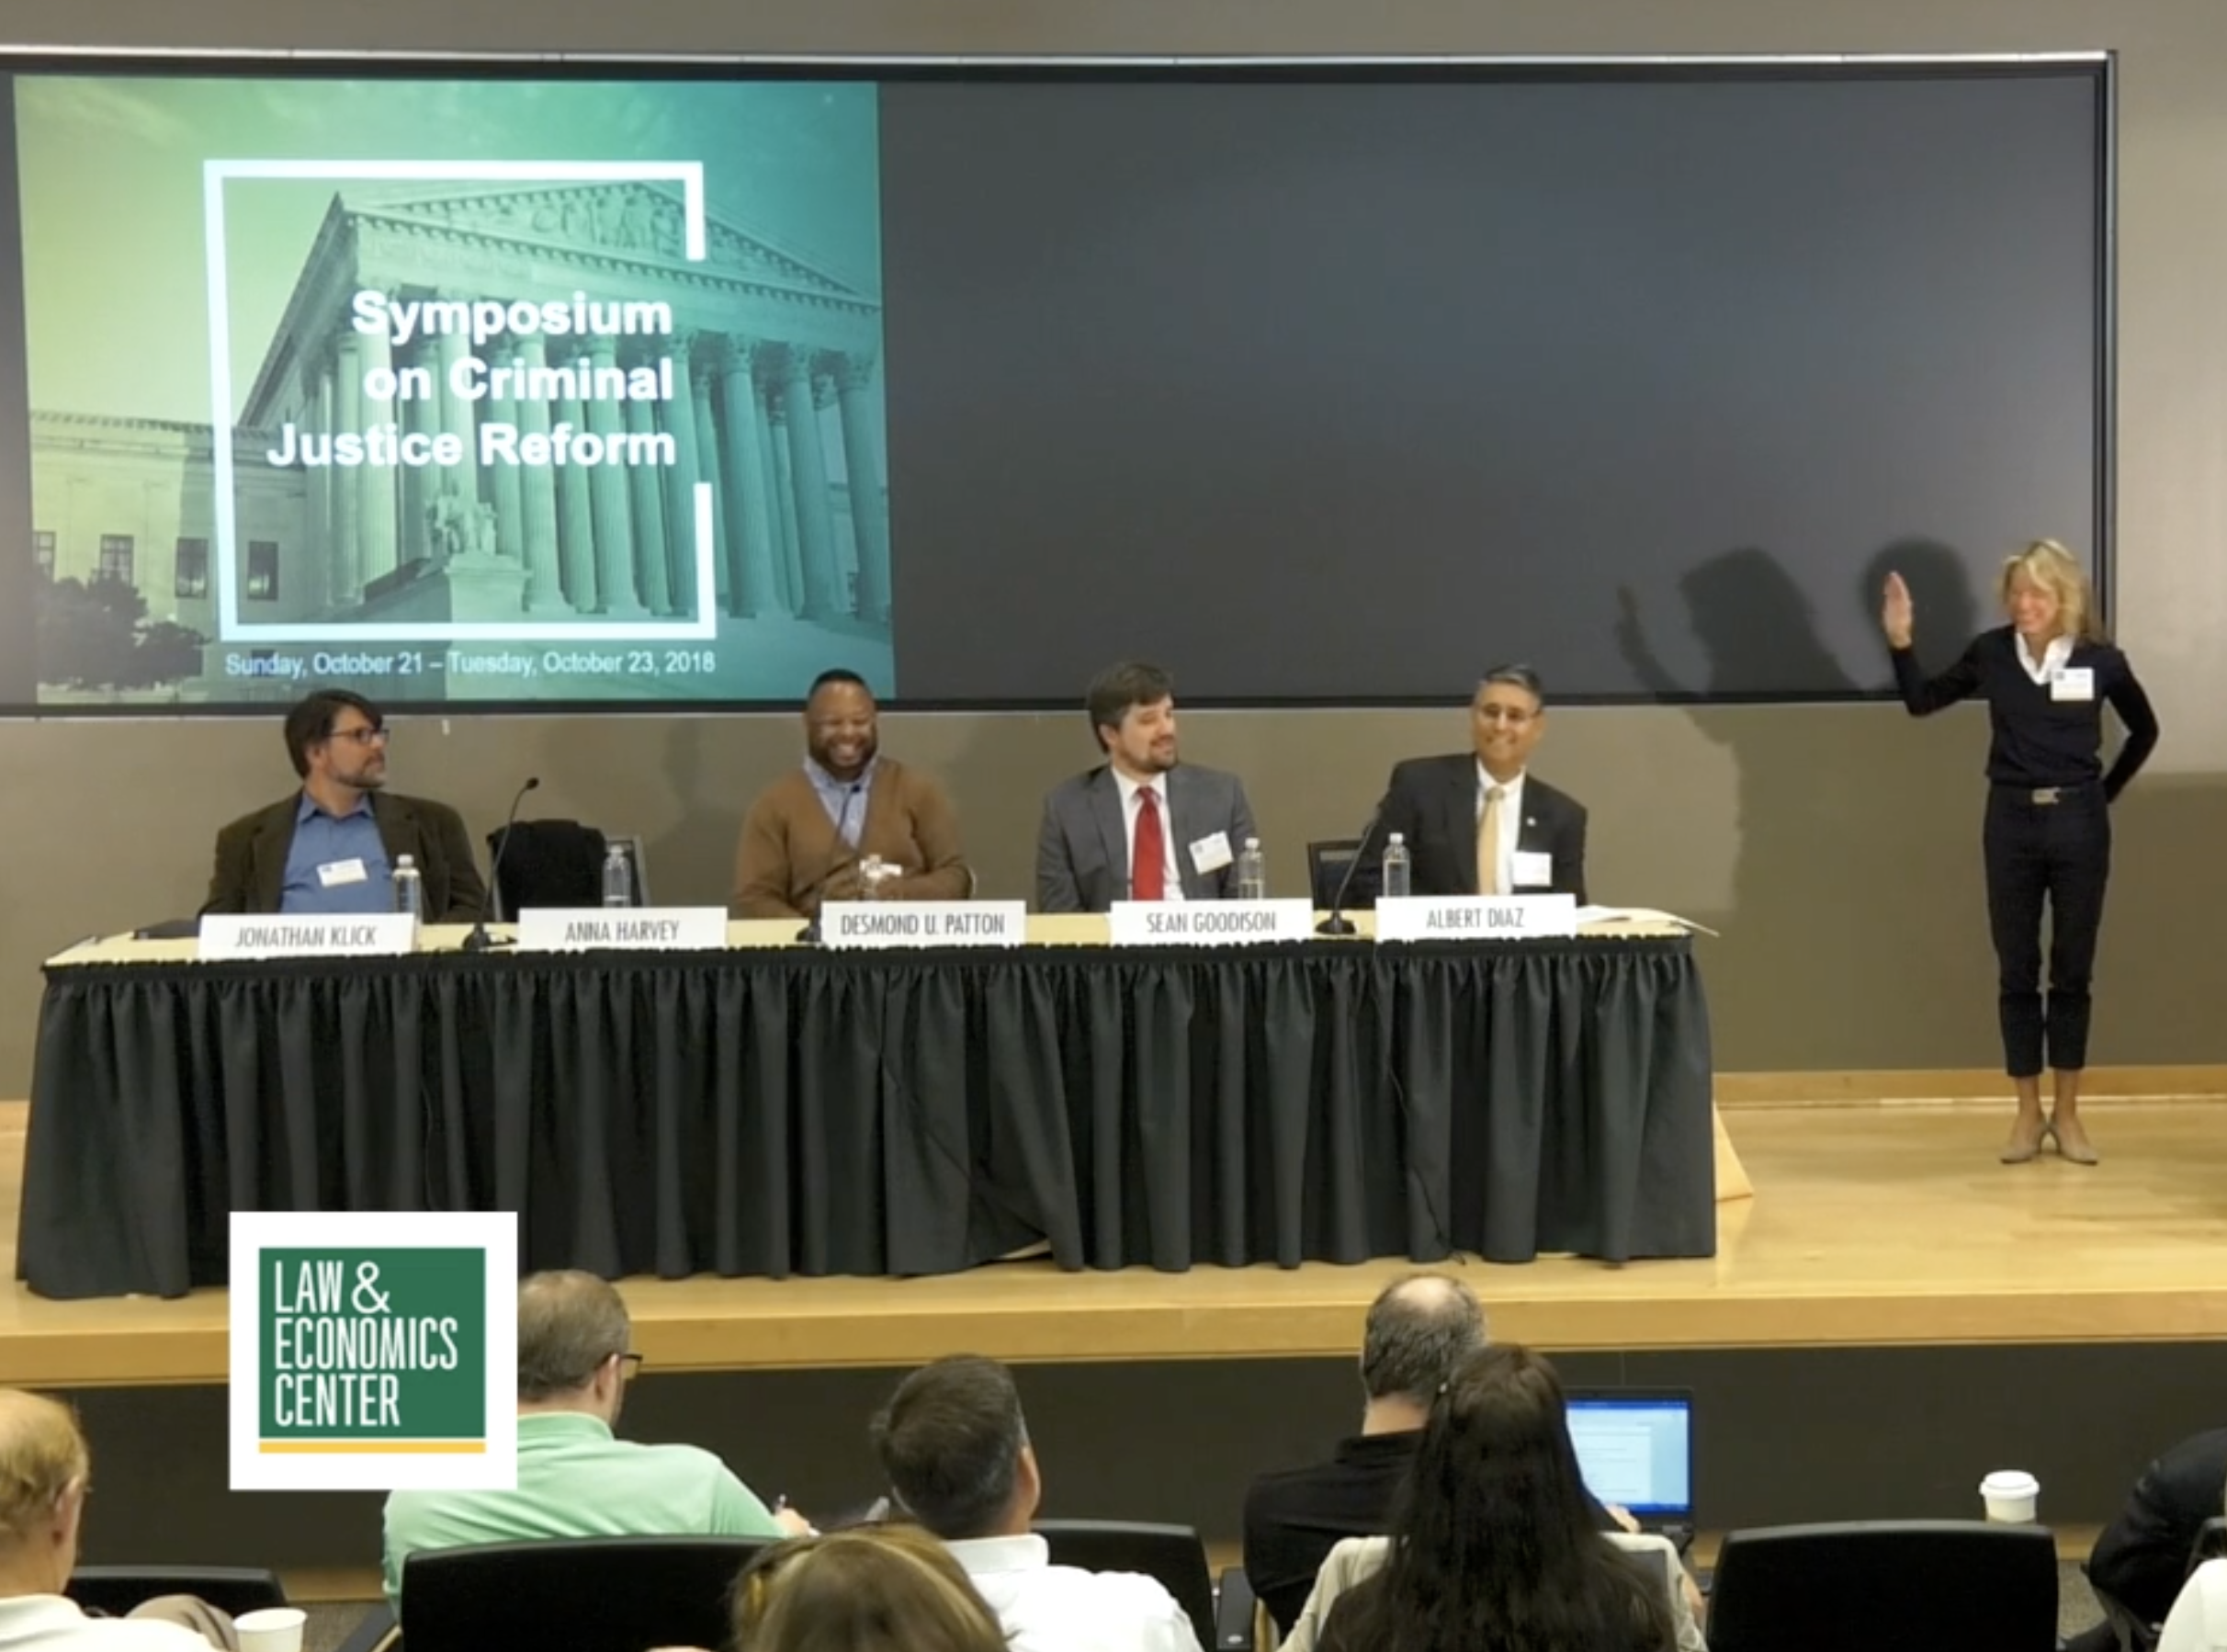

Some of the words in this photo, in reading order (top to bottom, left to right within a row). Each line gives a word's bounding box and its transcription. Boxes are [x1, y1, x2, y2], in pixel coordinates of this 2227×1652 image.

[353, 290, 673, 344] Symposium
[365, 366, 432, 401] on
[449, 356, 673, 401] Criminal
[267, 423, 463, 466] Justice
[480, 423, 675, 466] Reform
[225, 651, 309, 679] Sunday,
[313, 651, 393, 674] October
[398, 651, 422, 673] 21
[448, 651, 537, 678] Tuesday,
[543, 651, 623, 673] October
[627, 651, 660, 676] 23,
[665, 651, 716, 673] 2018
[841, 914, 920, 935] DESMOND
[924, 914, 940, 934] U.
[944, 912, 1005, 934] PATTON
[1147, 913, 1189, 934] SEAN
[1193, 911, 1276, 933] GOODISON
[1426, 908, 1482, 929] ALBERT
[1487, 908, 1524, 928] DIAZ
[235, 925, 324, 948] JONATHAN
[330, 924, 377, 945] KLICK
[565, 922, 612, 943] ANNA
[616, 921, 680, 942] HARVEY
